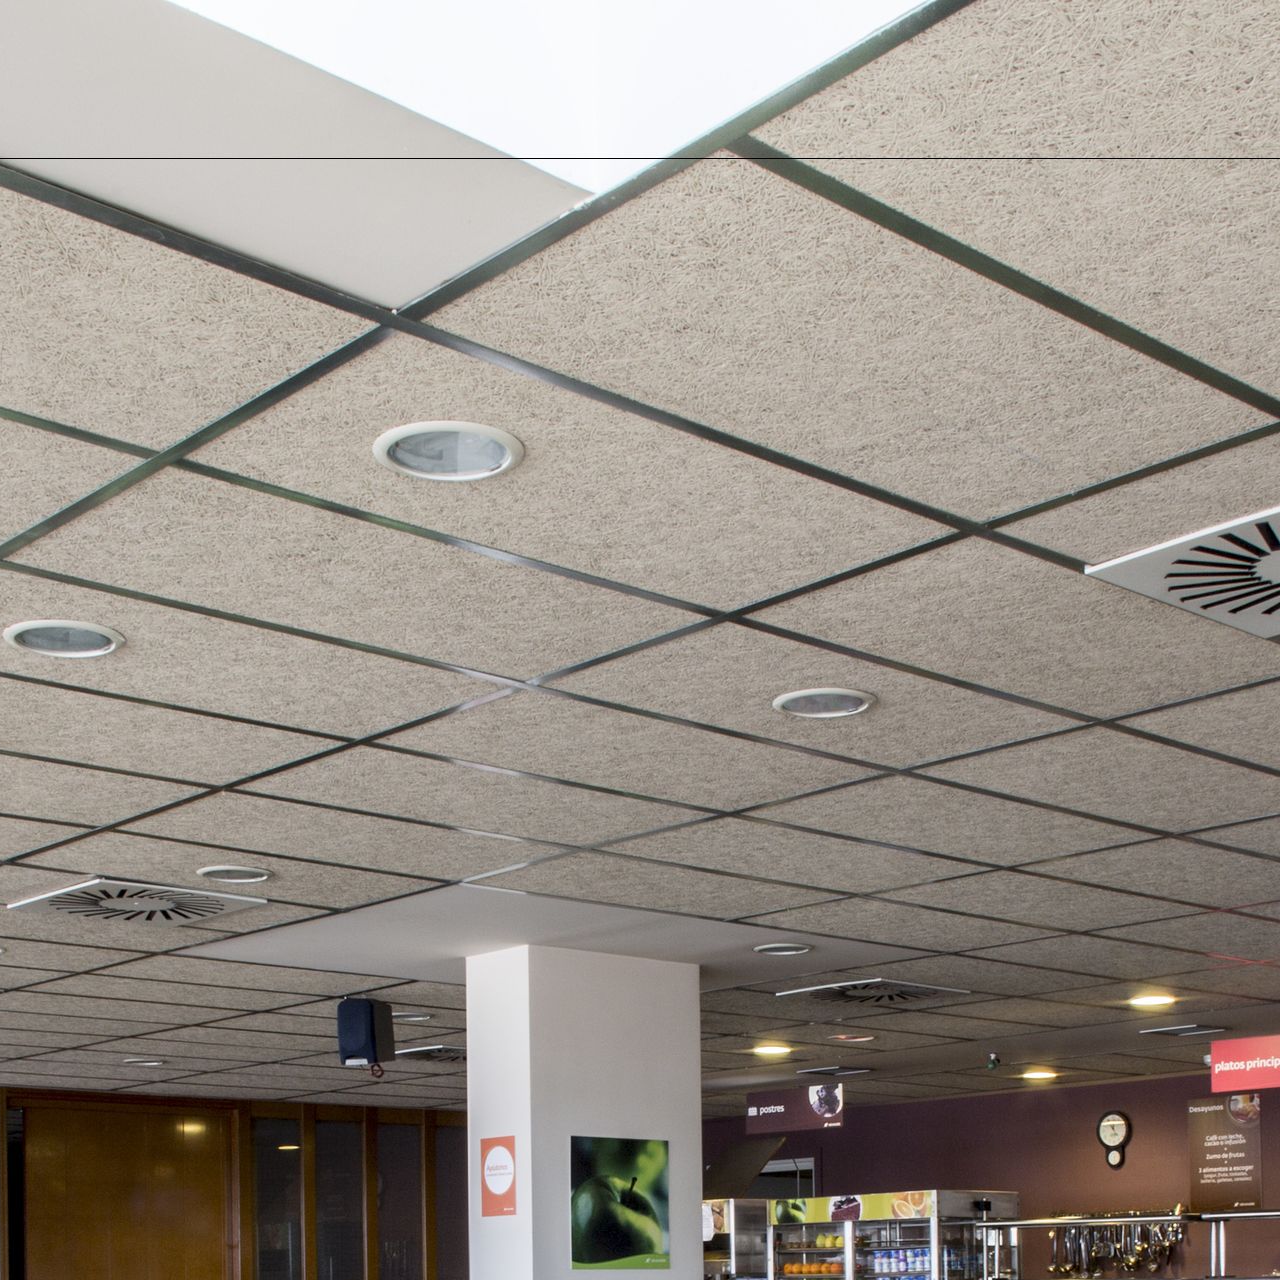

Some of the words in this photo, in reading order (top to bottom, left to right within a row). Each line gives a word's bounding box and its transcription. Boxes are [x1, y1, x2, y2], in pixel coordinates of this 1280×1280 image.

[1214, 1060, 1245, 1074] platos
[759, 1105, 785, 1116] postres
[1188, 1104, 1224, 1113] Desayunos
